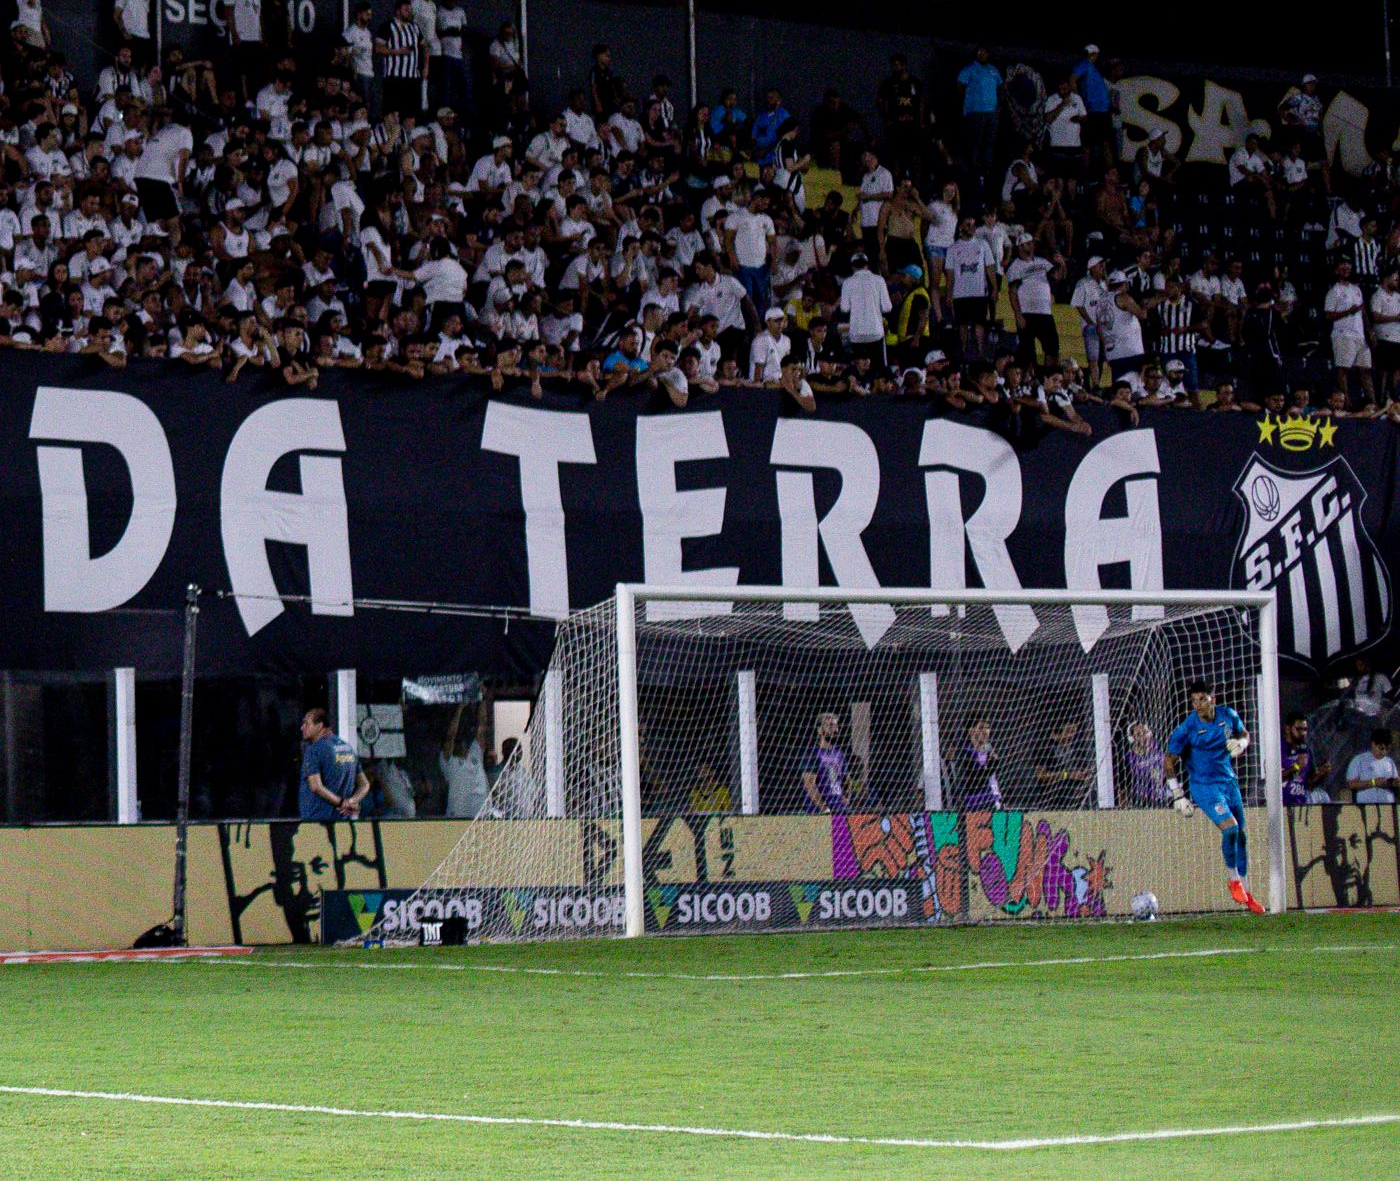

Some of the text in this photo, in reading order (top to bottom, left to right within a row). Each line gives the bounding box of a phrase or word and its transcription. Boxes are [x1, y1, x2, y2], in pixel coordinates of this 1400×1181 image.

[27, 385, 356, 638] DA
[480, 400, 1164, 656] TERRA
[383, 898, 483, 931] SICOOB
[533, 897, 626, 928] SICOOB
[677, 891, 772, 923] SICOOB
[818, 887, 909, 920] SICOOB
